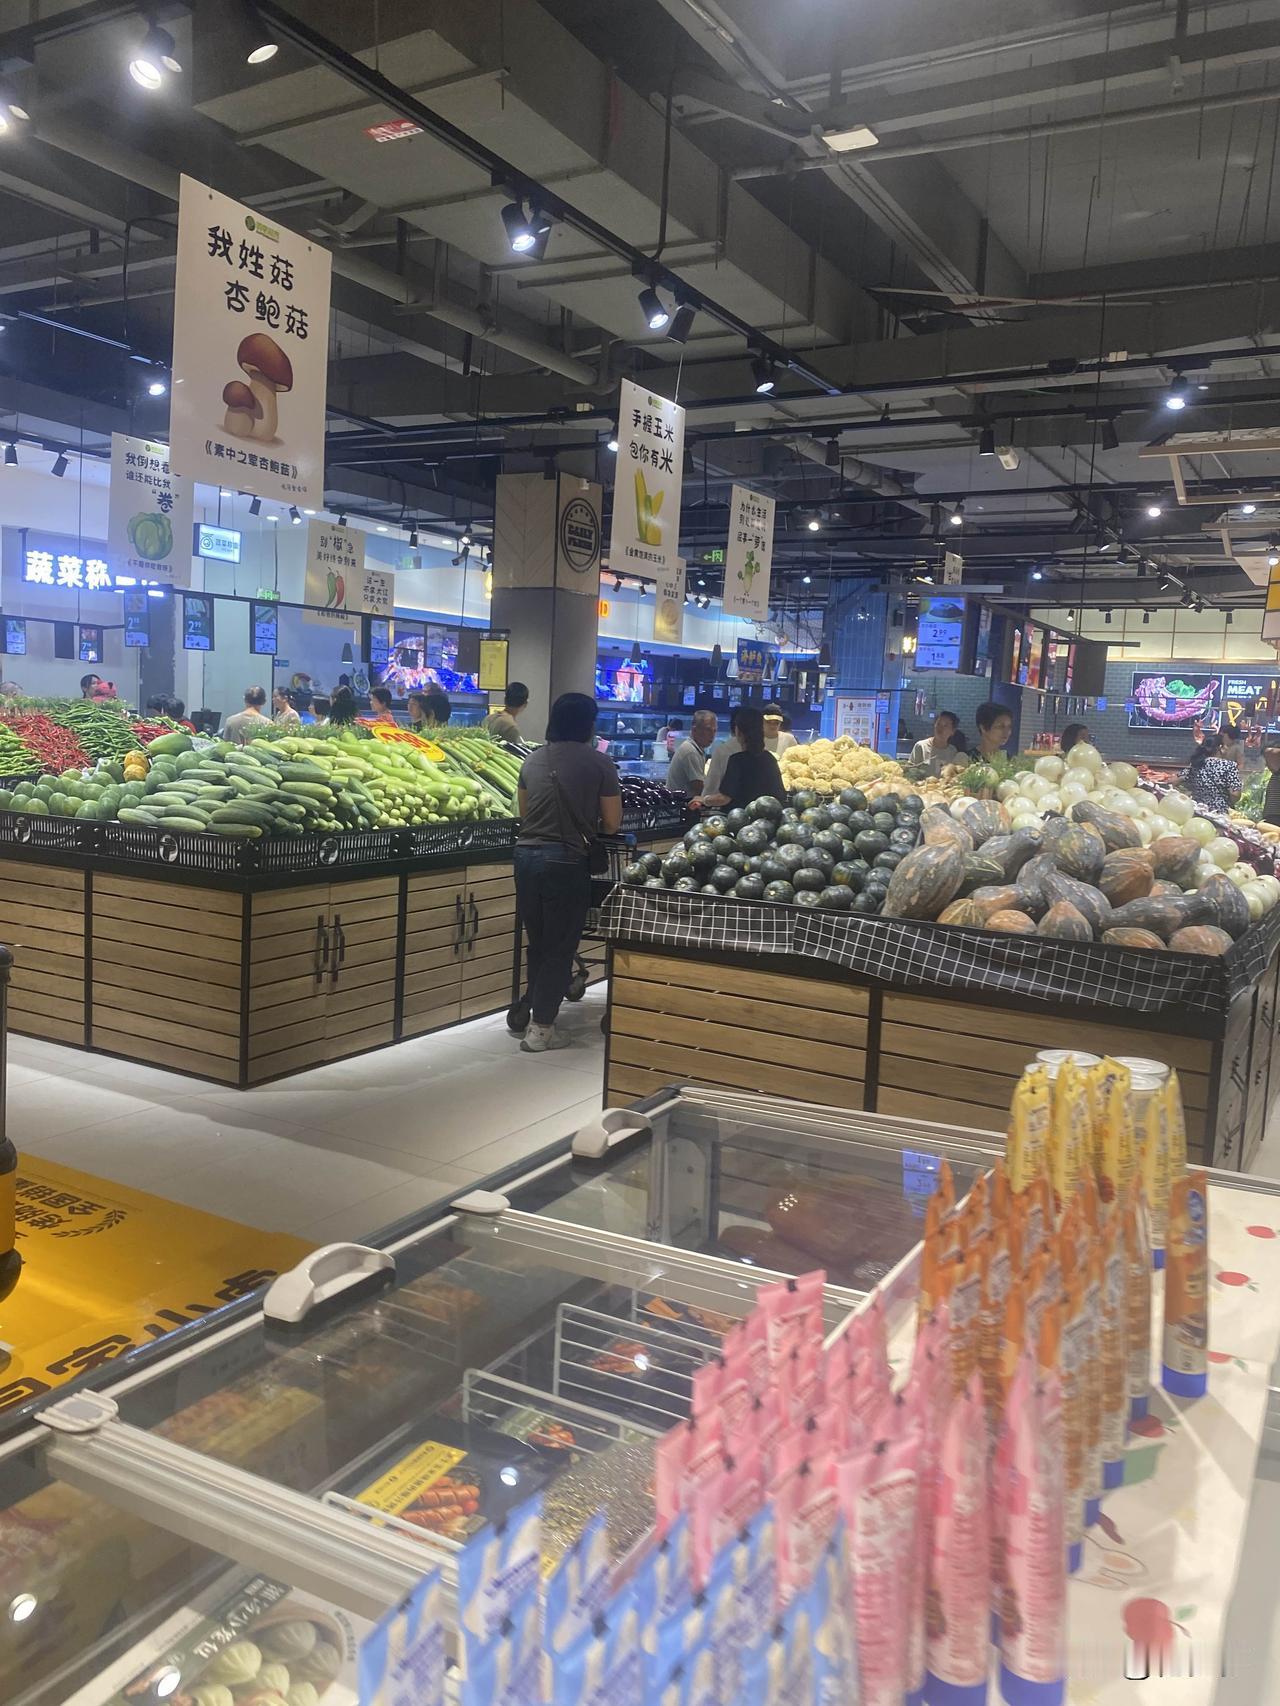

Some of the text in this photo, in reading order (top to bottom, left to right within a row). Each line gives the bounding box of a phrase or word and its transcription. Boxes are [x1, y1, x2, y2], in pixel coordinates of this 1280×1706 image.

[207, 225, 294, 291] 我姓菇
[224, 280, 308, 339] 杏鲍菇
[632, 409, 674, 443] 手握玉米
[629, 441, 673, 474] 包你有米
[125, 470, 171, 489] 谁还能比我
[1227, 685, 1263, 695] MEAT
